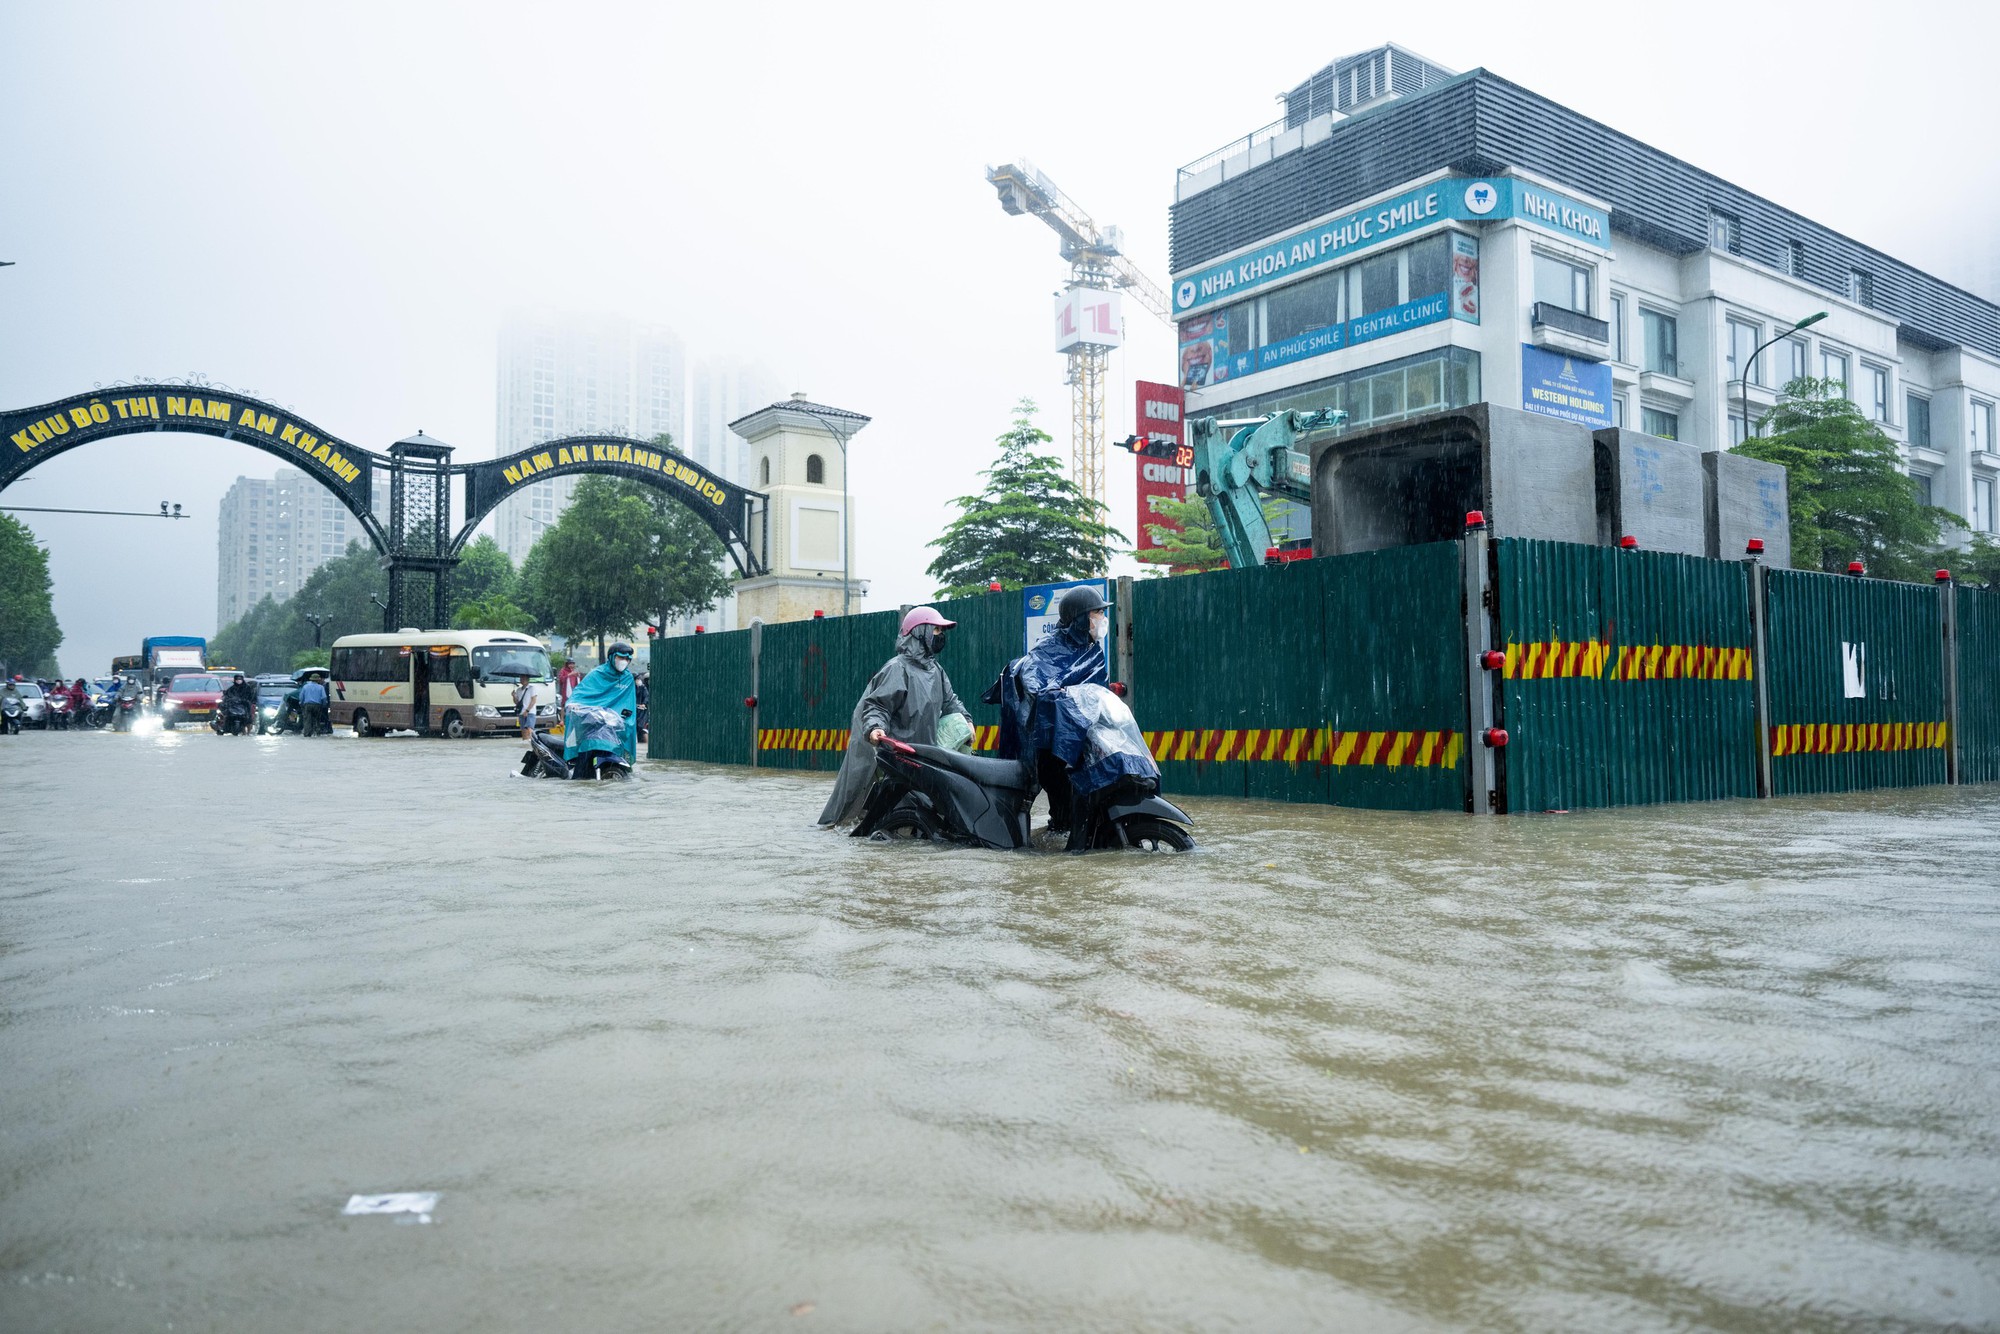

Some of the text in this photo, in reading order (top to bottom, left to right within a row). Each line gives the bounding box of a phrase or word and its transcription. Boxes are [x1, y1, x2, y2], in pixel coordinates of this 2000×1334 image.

[1524, 191, 1602, 240] NHA KHOA
[1201, 193, 1438, 298] NHA KHOA AN PHÚC SMILE
[1264, 301, 1443, 363] AN PHÚC SMILE DENTAL CLINIC
[1145, 400, 1180, 423] KHU
[1531, 387, 1604, 414] WESTERN HOLDINGS
[10, 396, 361, 484] KHU ĐÔ THỊ NAM AN KHÁNH
[1176, 446, 1193, 468] 02
[502, 443, 726, 506] NAM AN KHÁNH SUDICO
